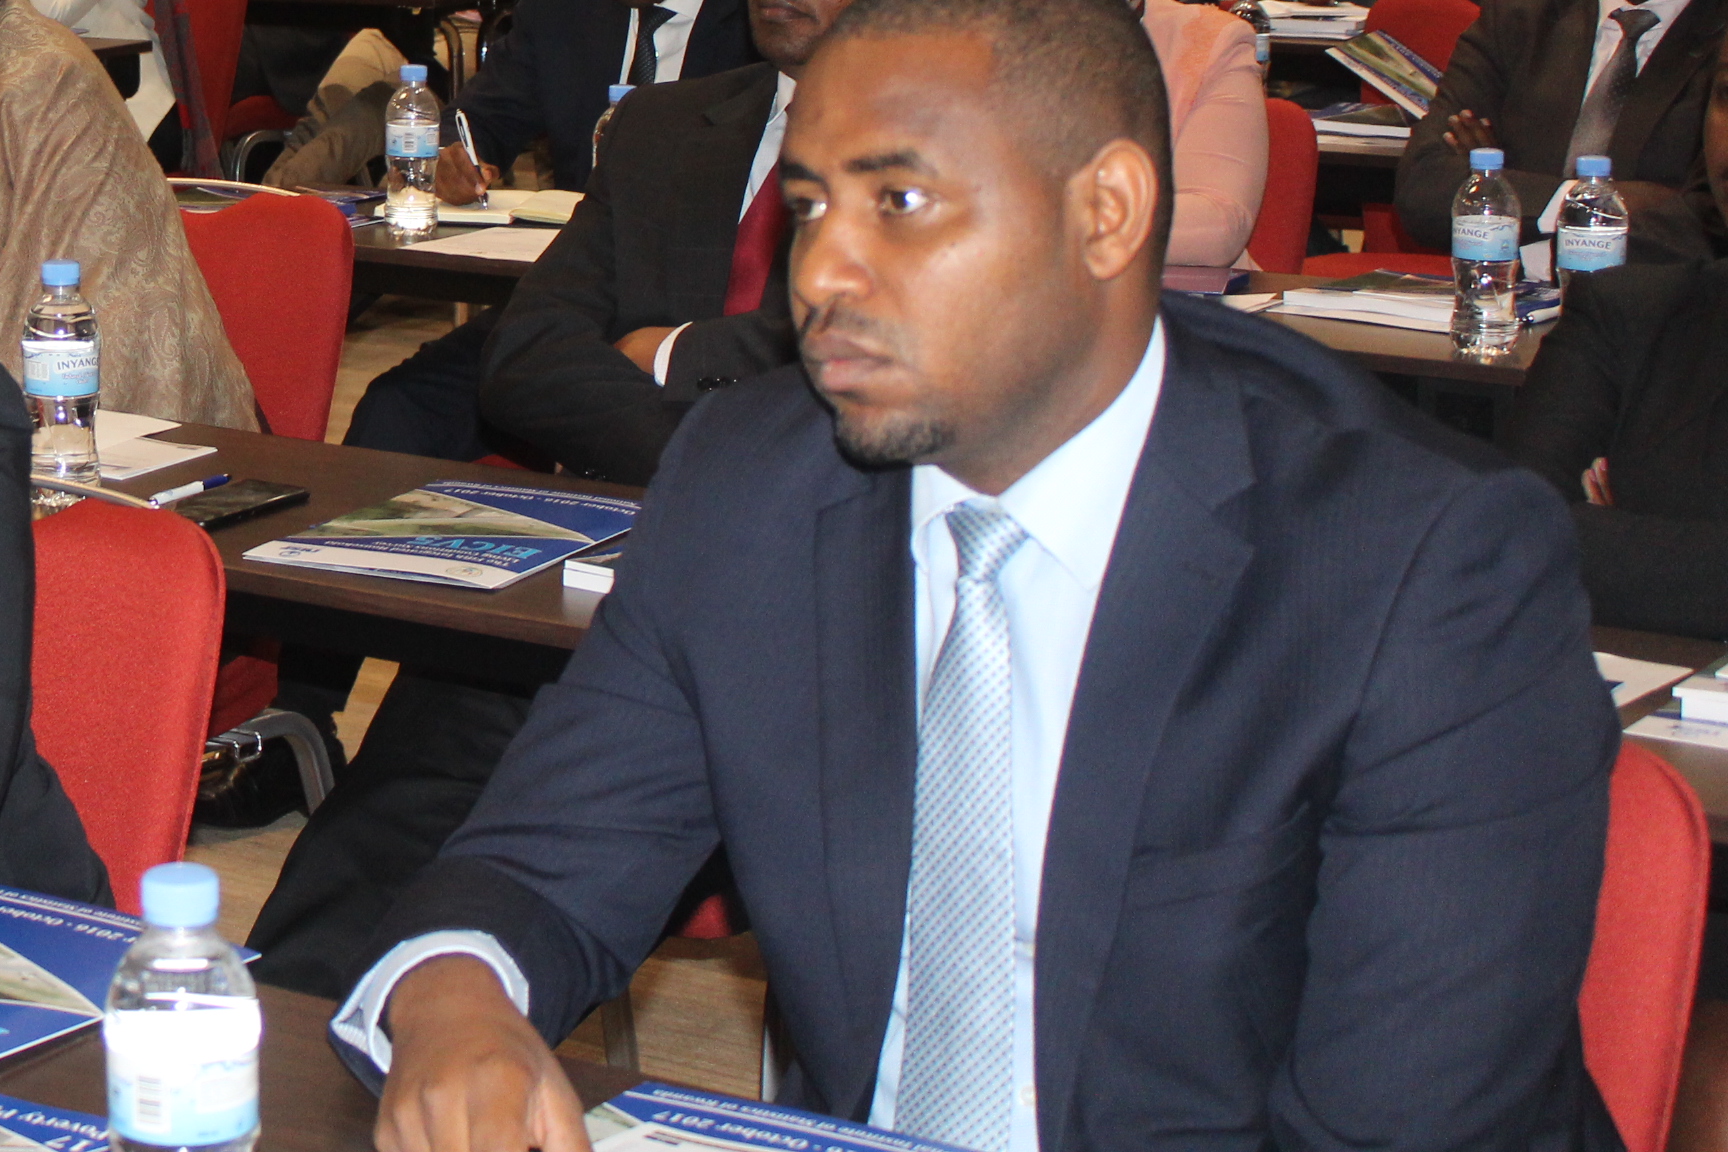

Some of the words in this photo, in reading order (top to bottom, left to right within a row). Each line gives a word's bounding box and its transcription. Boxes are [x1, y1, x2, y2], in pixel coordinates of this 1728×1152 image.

[1564, 239, 1613, 250] INYANGE
[480, 491, 535, 502] October
[580, 502, 637, 515] October
[406, 536, 543, 559] EICV5
[480, 552, 521, 564] Living
[485, 558, 510, 567] The
[20, 893, 80, 912] Statistics
[73, 923, 125, 941] 2016
[652, 1088, 720, 1108] Rwanda
[652, 1109, 717, 1129] 2017
[739, 1105, 819, 1127] Statistics
[16, 1110, 110, 1142] Poverty
[714, 1122, 809, 1151] October
